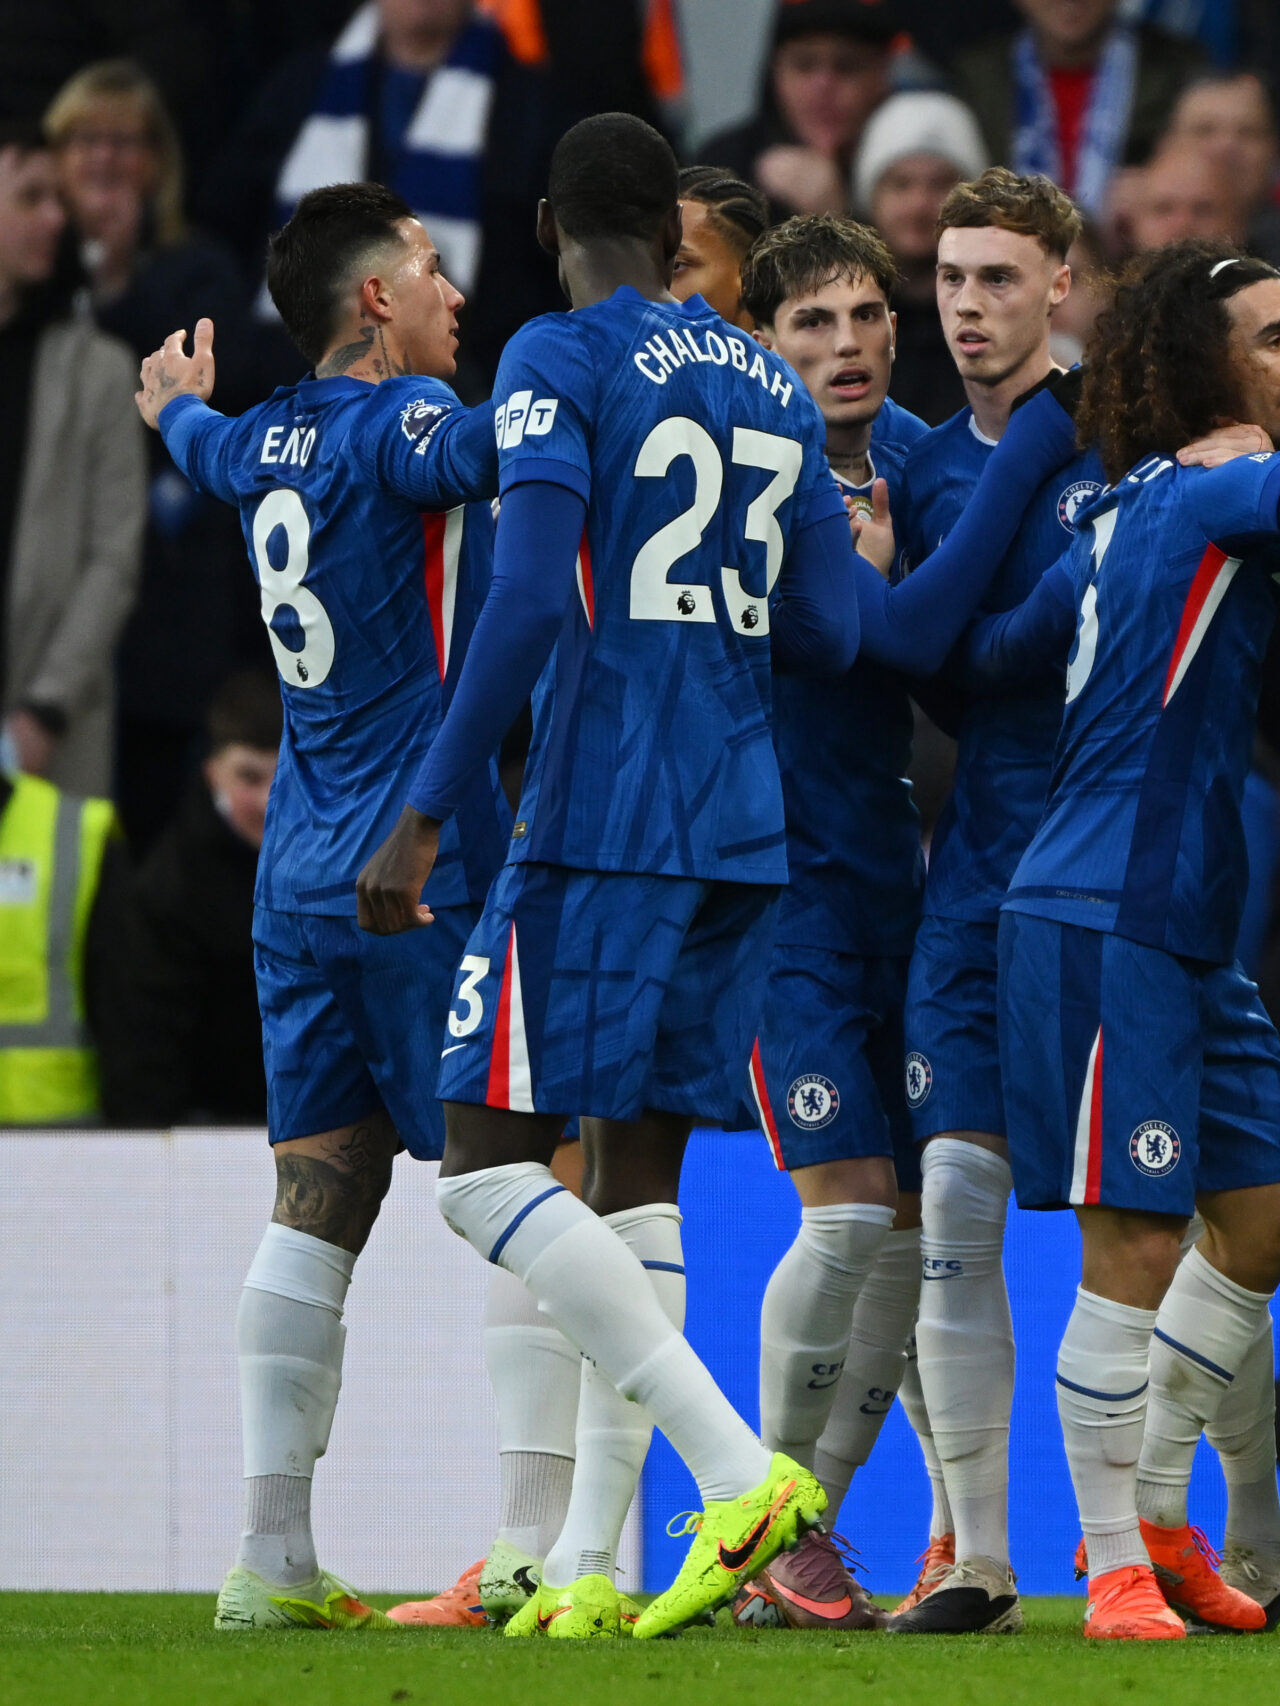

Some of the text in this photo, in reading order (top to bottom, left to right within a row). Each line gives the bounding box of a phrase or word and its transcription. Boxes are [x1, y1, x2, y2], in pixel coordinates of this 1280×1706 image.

[634, 328, 794, 408] CHALOBAH
[629, 415, 804, 637] 23
[252, 488, 336, 689] 8
[447, 954, 491, 1038] 3
[792, 1075, 828, 1092] CHELSEA
[1138, 1122, 1172, 1136] CHELSEA
[811, 1361, 845, 1376] CF
